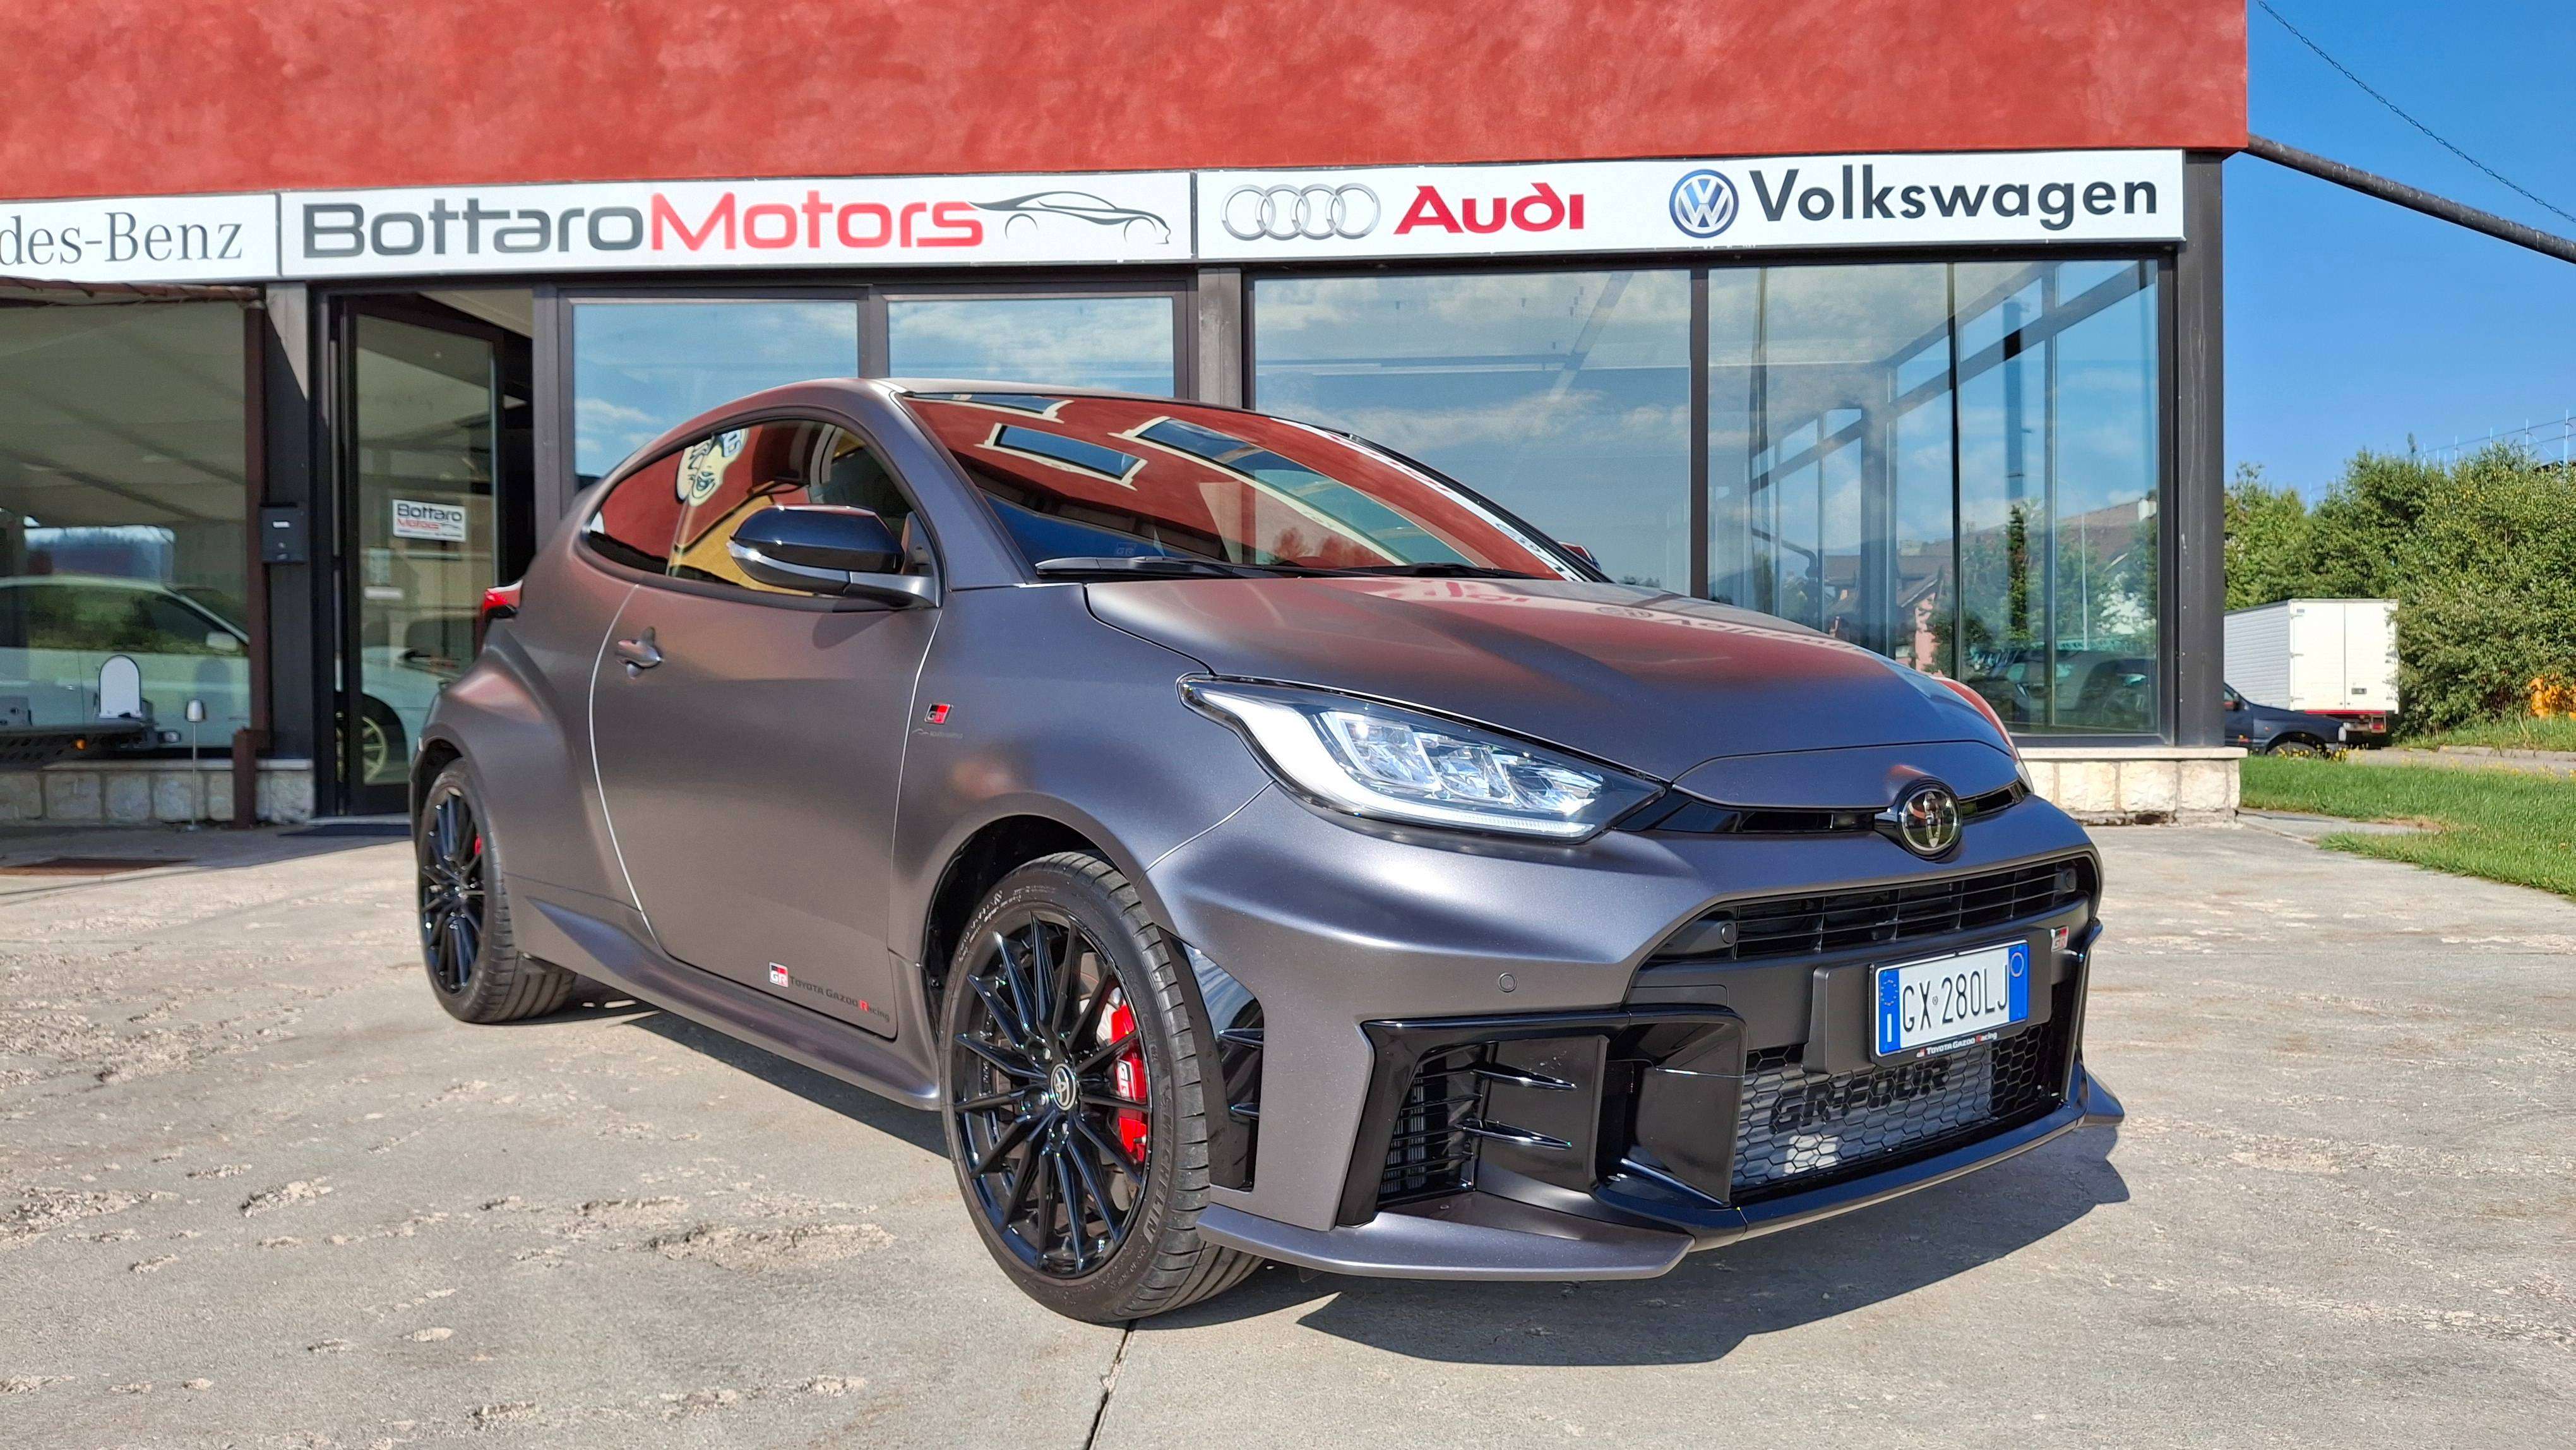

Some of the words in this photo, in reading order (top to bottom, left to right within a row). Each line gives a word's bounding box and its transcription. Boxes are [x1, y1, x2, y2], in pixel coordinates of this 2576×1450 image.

[1393, 182, 1585, 235] Audi
[1748, 164, 2157, 231] Volkswagen
[0, 211, 243, 266] des-Benz
[398, 503, 462, 522] Bottaro
[770, 970, 789, 987] GR
[790, 976, 824, 995] TOYOTA
[826, 988, 859, 1007] GAZOO
[1902, 980, 1932, 1033] GX
[1941, 964, 2008, 1025] 280LJ
[1926, 1043, 1952, 1055] TOYOTA
[1952, 1038, 1976, 1048] GAZOO
[1976, 1032, 1998, 1044] Racing
